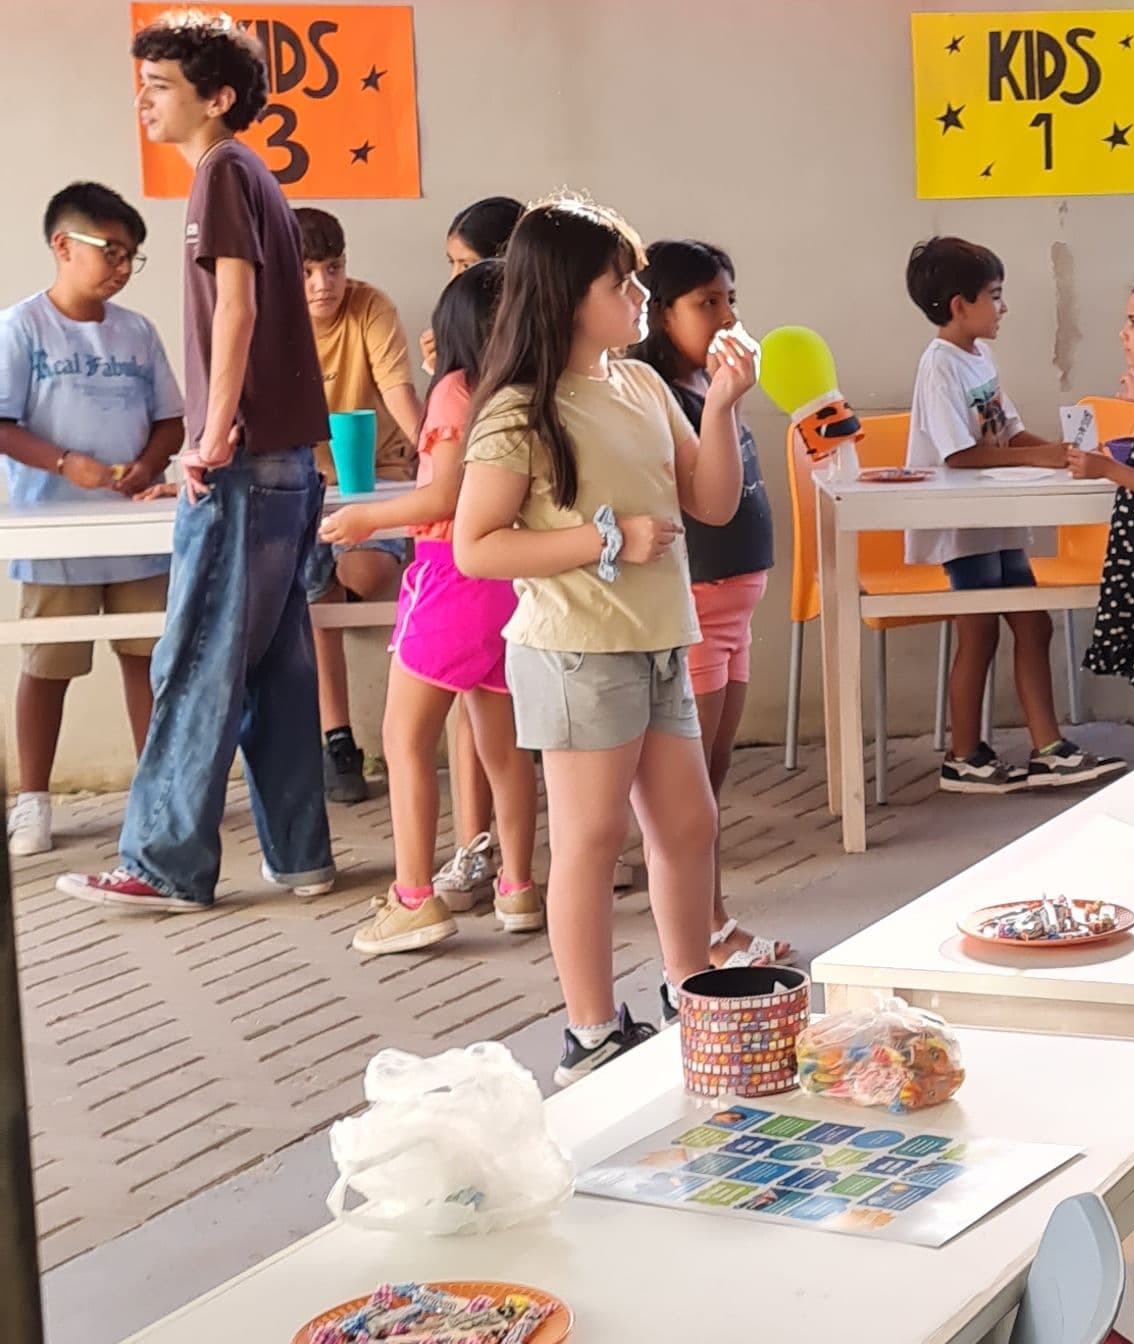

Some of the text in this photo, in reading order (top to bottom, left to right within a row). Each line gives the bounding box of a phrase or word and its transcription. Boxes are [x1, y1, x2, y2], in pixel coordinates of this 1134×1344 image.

[237, 19, 339, 99] IDS
[988, 27, 1102, 105] KIDS
[256, 103, 310, 185] 3
[1029, 112, 1053, 170] 1
